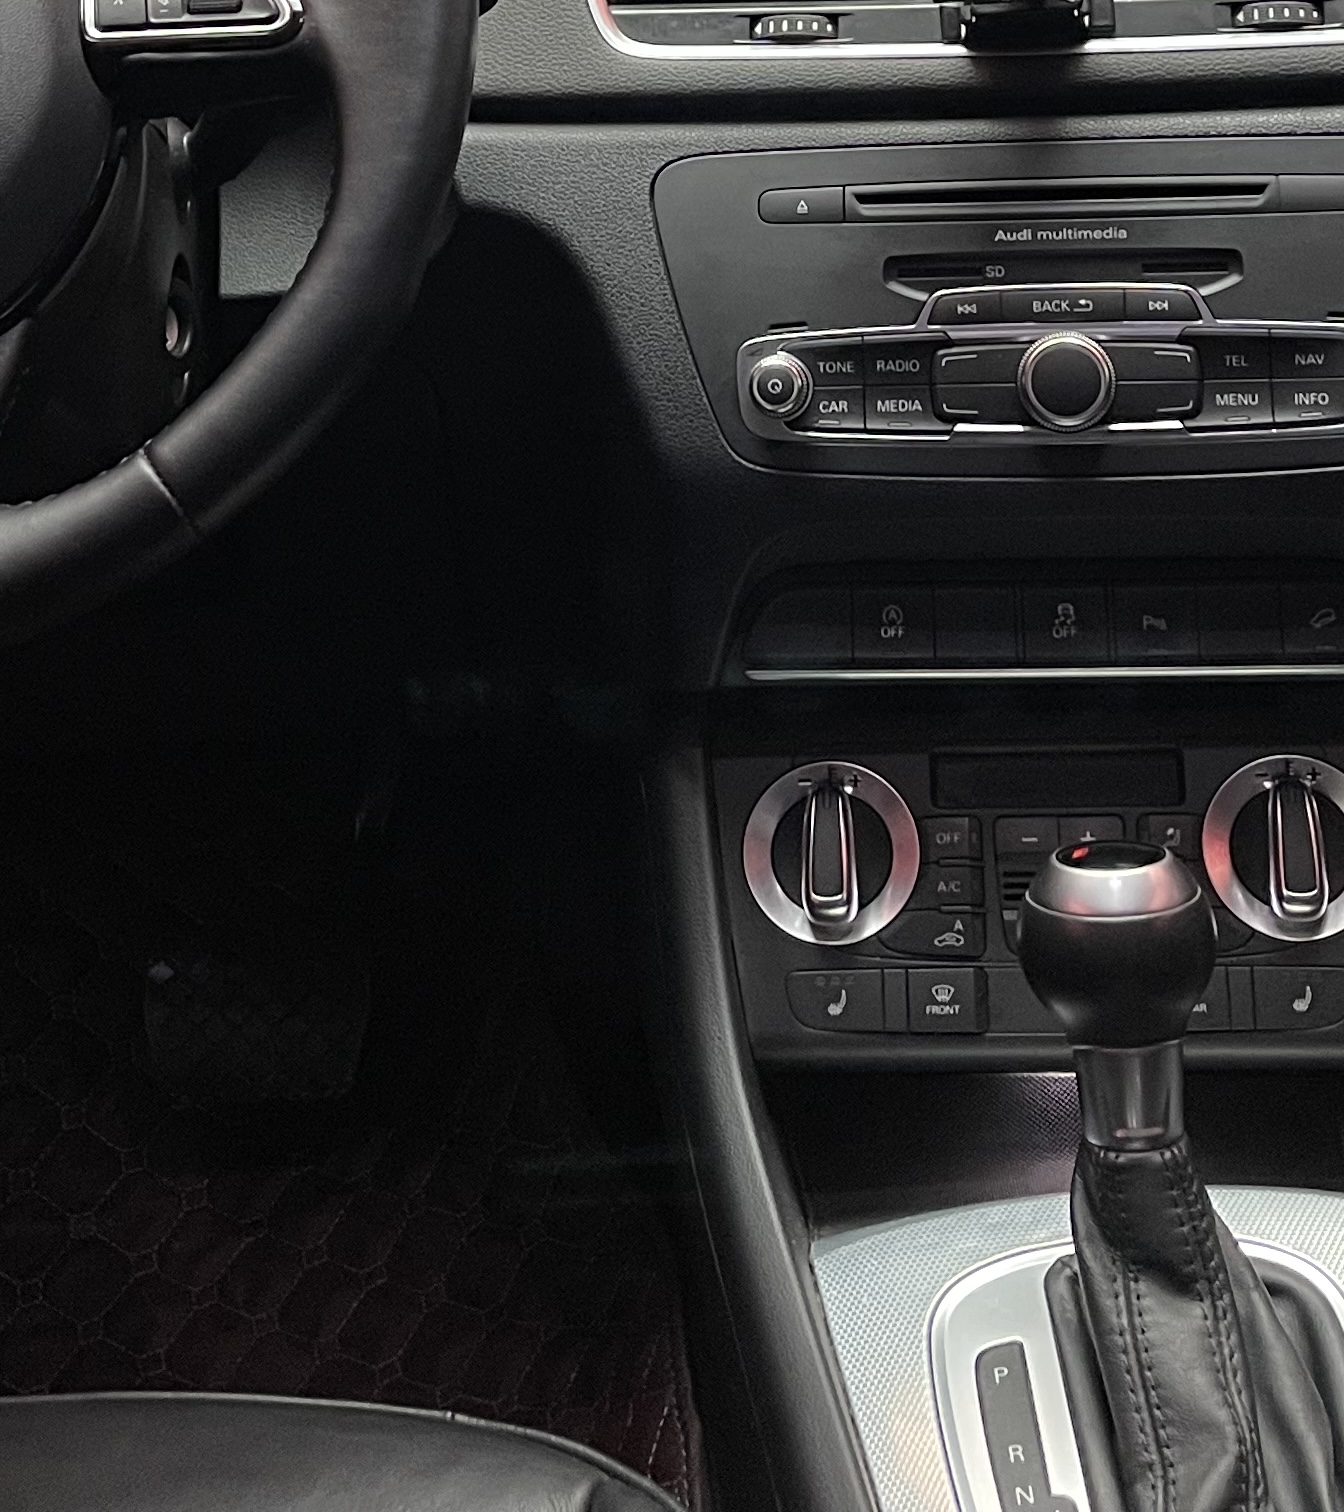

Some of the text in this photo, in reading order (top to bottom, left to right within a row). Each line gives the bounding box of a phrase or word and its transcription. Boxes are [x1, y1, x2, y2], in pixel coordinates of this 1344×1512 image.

[994, 225, 1129, 242] Audi multimedia
[985, 264, 1006, 278] SD
[1032, 298, 1071, 313] BACK
[876, 358, 921, 374] RADIO
[1223, 353, 1250, 367] TEL
[1294, 351, 1326, 367] NAV
[817, 360, 855, 375] TONE
[819, 399, 849, 415] CAR
[876, 397, 923, 414] MEDIA
[1215, 392, 1260, 408] MENU
[1293, 391, 1331, 408] INFO
[880, 626, 906, 638] OFF
[1052, 625, 1077, 639] OFF
[935, 831, 961, 845] OFF
[936, 880, 961, 893] A/C
[925, 1003, 961, 1016] FRONT
[992, 1366, 1009, 1384] P
[1008, 1444, 1026, 1463] R
[1016, 1486, 1035, 1505] N
